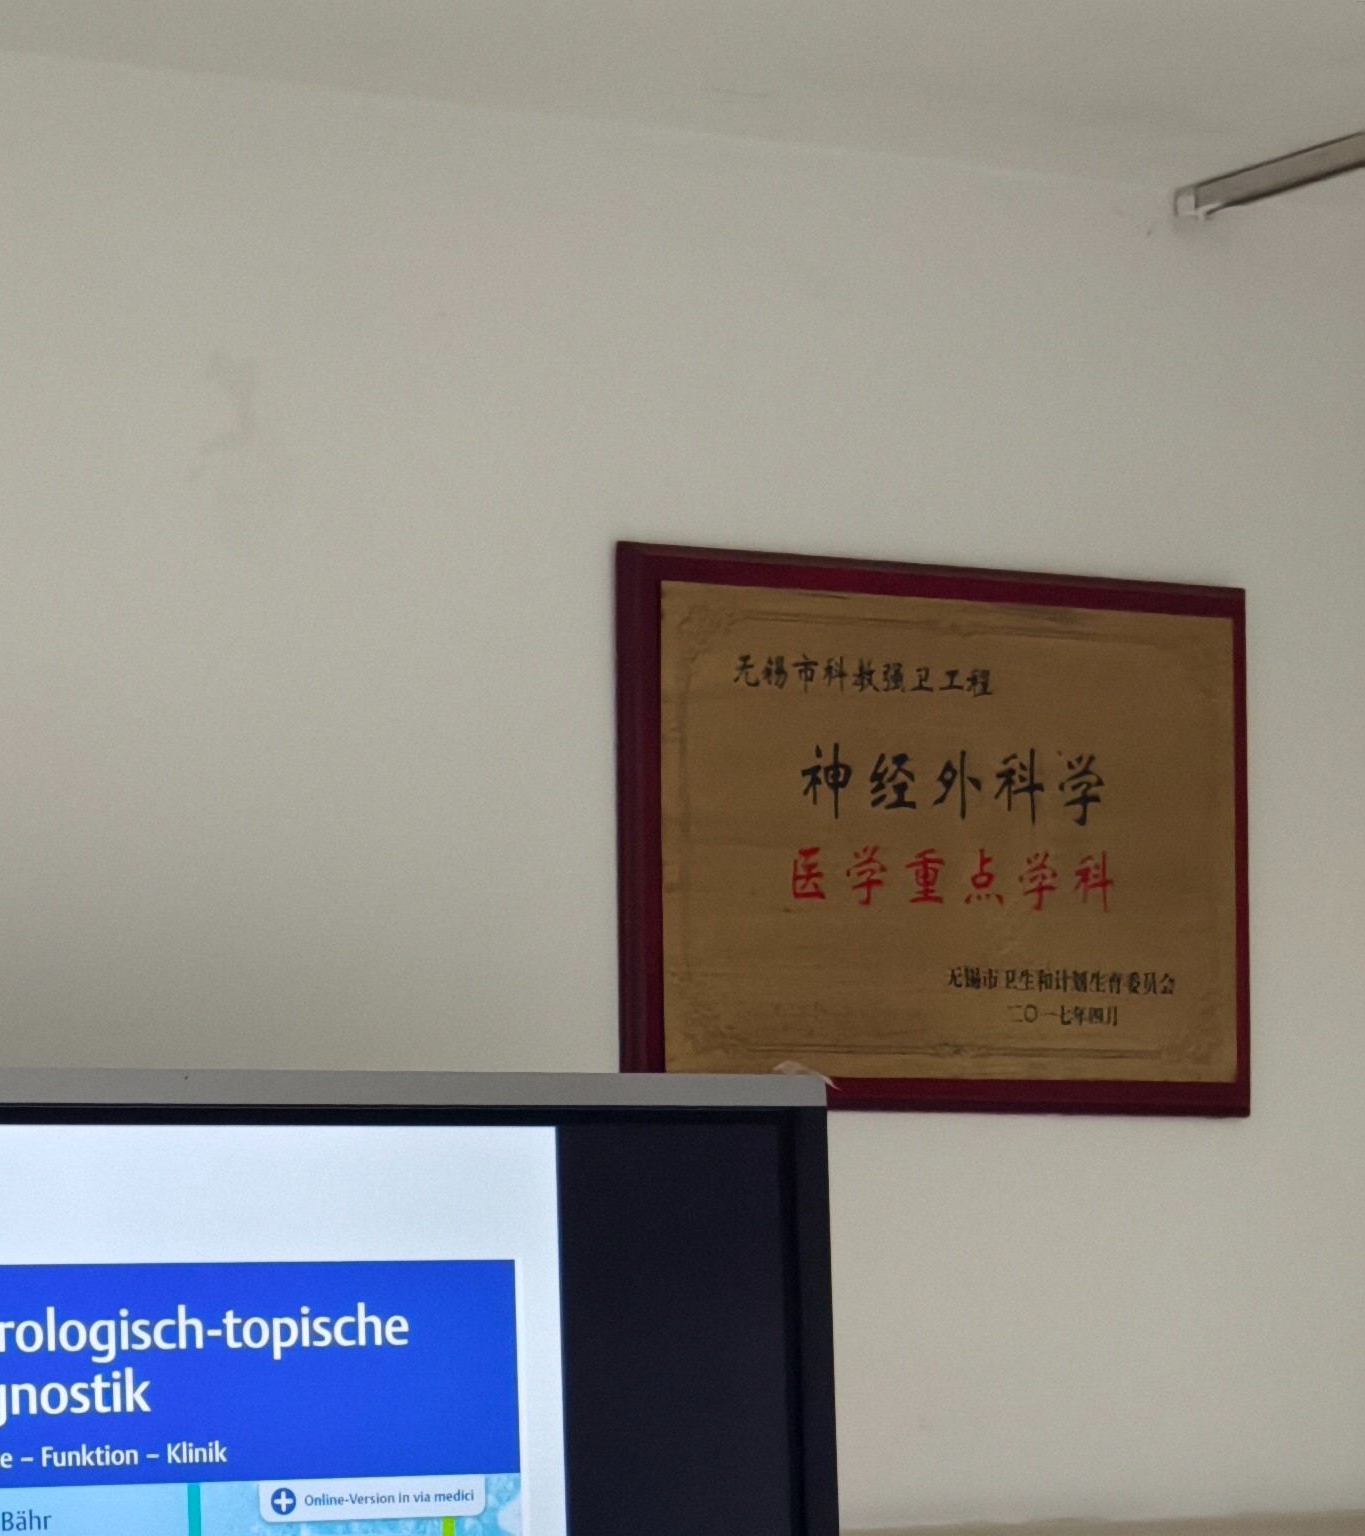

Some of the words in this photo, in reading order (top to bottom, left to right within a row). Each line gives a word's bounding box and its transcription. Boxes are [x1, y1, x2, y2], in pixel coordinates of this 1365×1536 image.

[734, 653, 994, 698] 无锡市科教强卫工程
[801, 742, 1106, 826] 神经外科学
[790, 846, 1115, 911] 医学重点学科
[41, 1445, 139, 1468] Funktion
[166, 1441, 227, 1465] Klinik
[304, 1493, 396, 1507] Online-Version
[413, 1490, 431, 1503] via
[434, 1489, 475, 1502] medici
[0, 1508, 52, 1532] Bähr
